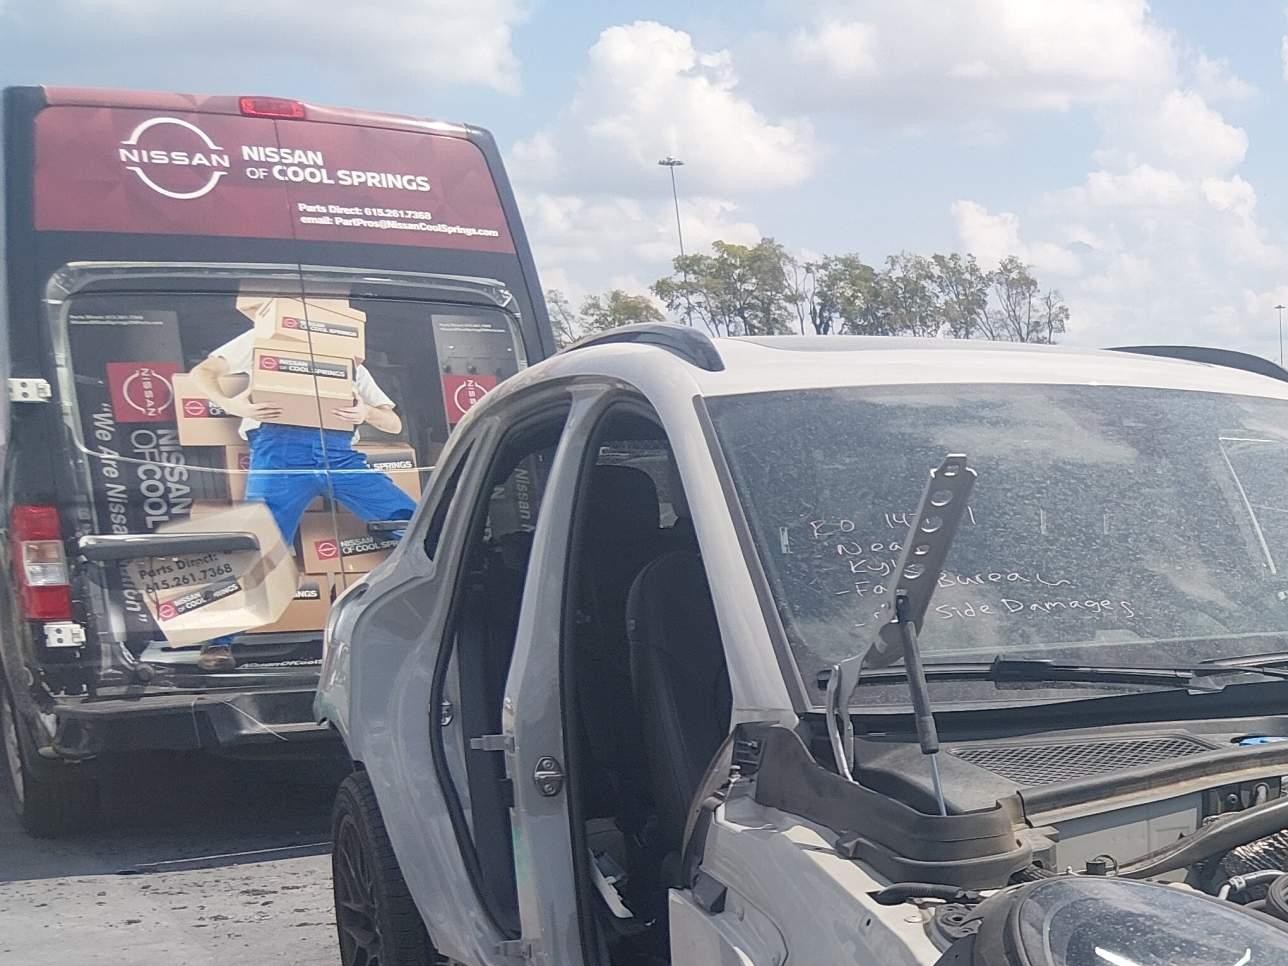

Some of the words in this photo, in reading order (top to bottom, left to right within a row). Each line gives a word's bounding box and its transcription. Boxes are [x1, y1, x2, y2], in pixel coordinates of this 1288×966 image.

[119, 148, 230, 167] NISSAN
[241, 145, 324, 166] NISSAN
[246, 166, 268, 180] OF
[272, 165, 335, 185] COOL
[337, 169, 431, 192] SPRINGS
[298, 203, 327, 213] Parts
[329, 205, 363, 216] Direct:
[300, 215, 333, 225] email:
[139, 367, 157, 417] NISSAN
[130, 429, 160, 463] OF
[98, 445, 120, 478] Are
[156, 429, 193, 514] NISSAN
[105, 483, 129, 535] Nissa
[137, 463, 170, 529] COOL
[356, 543, 380, 553] COOL
[138, 562, 173, 580] Parts
[175, 553, 218, 571] Direct:
[144, 563, 233, 594] 615.261.7368
[935, 602, 993, 619] Side
[1001, 598, 1135, 617] Damages
